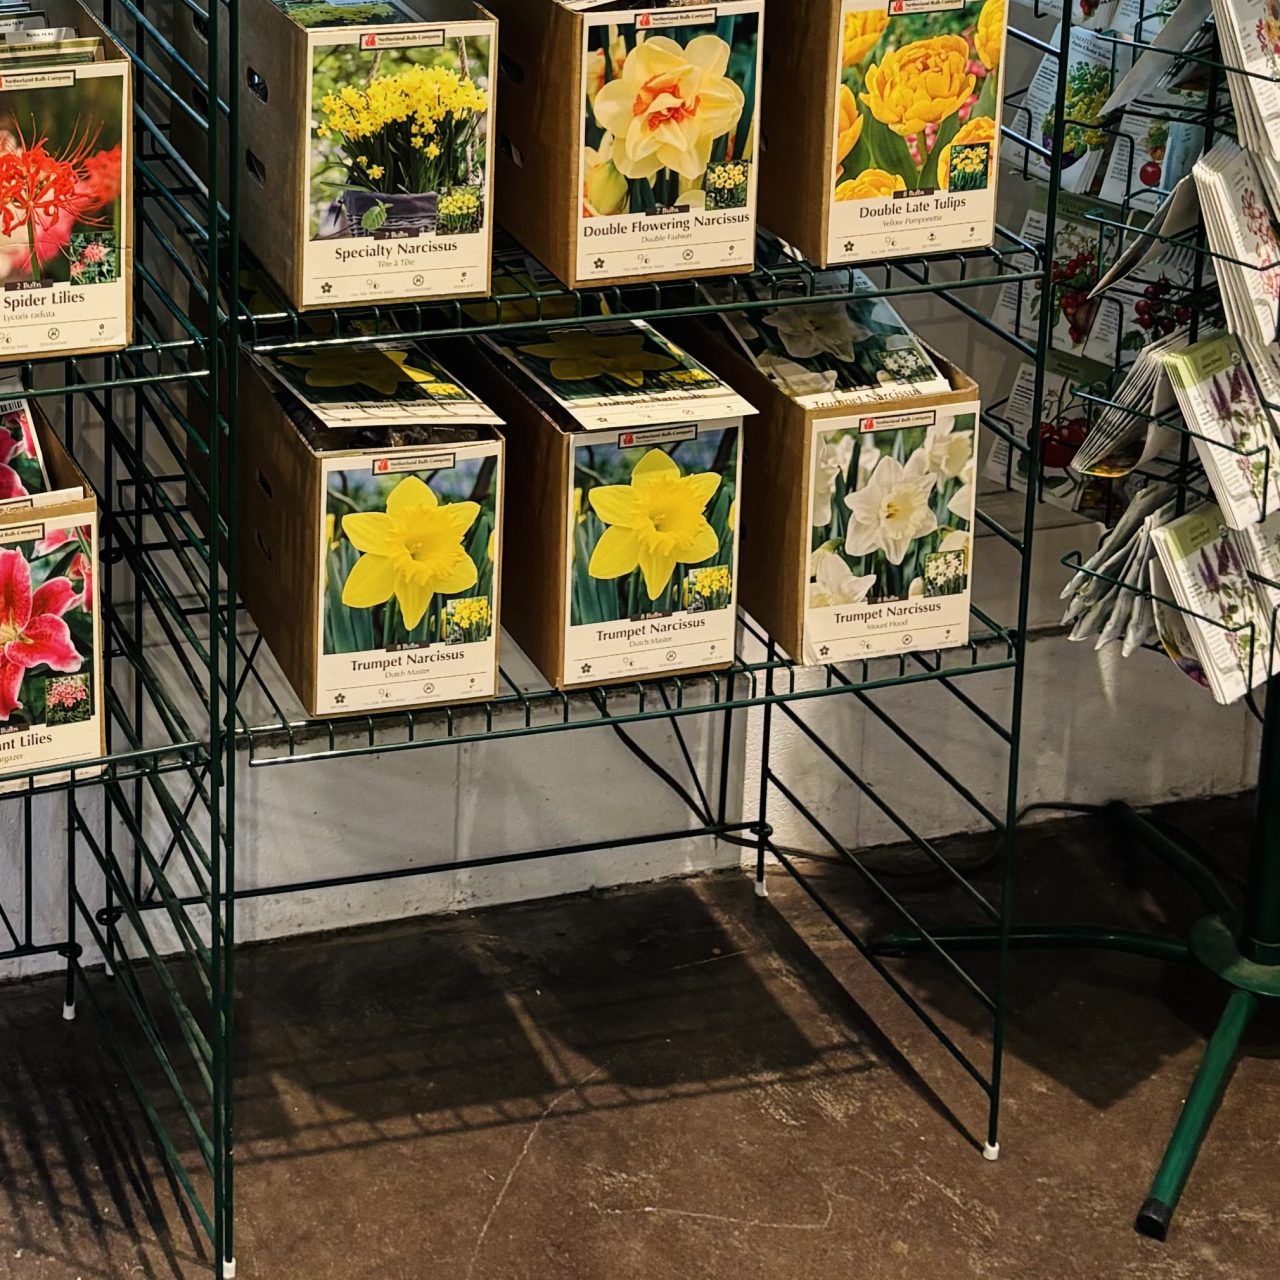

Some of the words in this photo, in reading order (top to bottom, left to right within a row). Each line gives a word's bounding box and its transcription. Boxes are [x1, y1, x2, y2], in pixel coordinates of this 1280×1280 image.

[860, 205, 902, 218] Double
[906, 202, 929, 214] Late
[934, 197, 966, 211] Tulips
[584, 222, 627, 237] Double
[631, 219, 690, 233] Flowering
[694, 212, 750, 227] Narcissus
[641, 235, 666, 243] Double
[335, 244, 393, 262] Specialty
[398, 241, 457, 253] Narcissus
[4, 295, 47, 312] Spider
[52, 291, 85, 305] Lilies
[3, 313, 28, 322] Lycoris
[31, 311, 56, 319] radiata
[834, 609, 882, 624] Trumpet
[886, 602, 941, 617] Narcissus
[597, 625, 646, 641] Trumpet
[650, 619, 706, 633] Narcissus
[867, 622, 888, 630] Mount
[890, 620, 908, 628] Hood
[629, 640, 649, 648] Dutch
[651, 637, 672, 645] Master
[351, 655, 402, 671] Trumpet
[407, 650, 464, 665] Narcissus
[385, 671, 405, 679] Dutch
[407, 668, 429, 676] Master
[20, 733, 53, 747] Lilies
